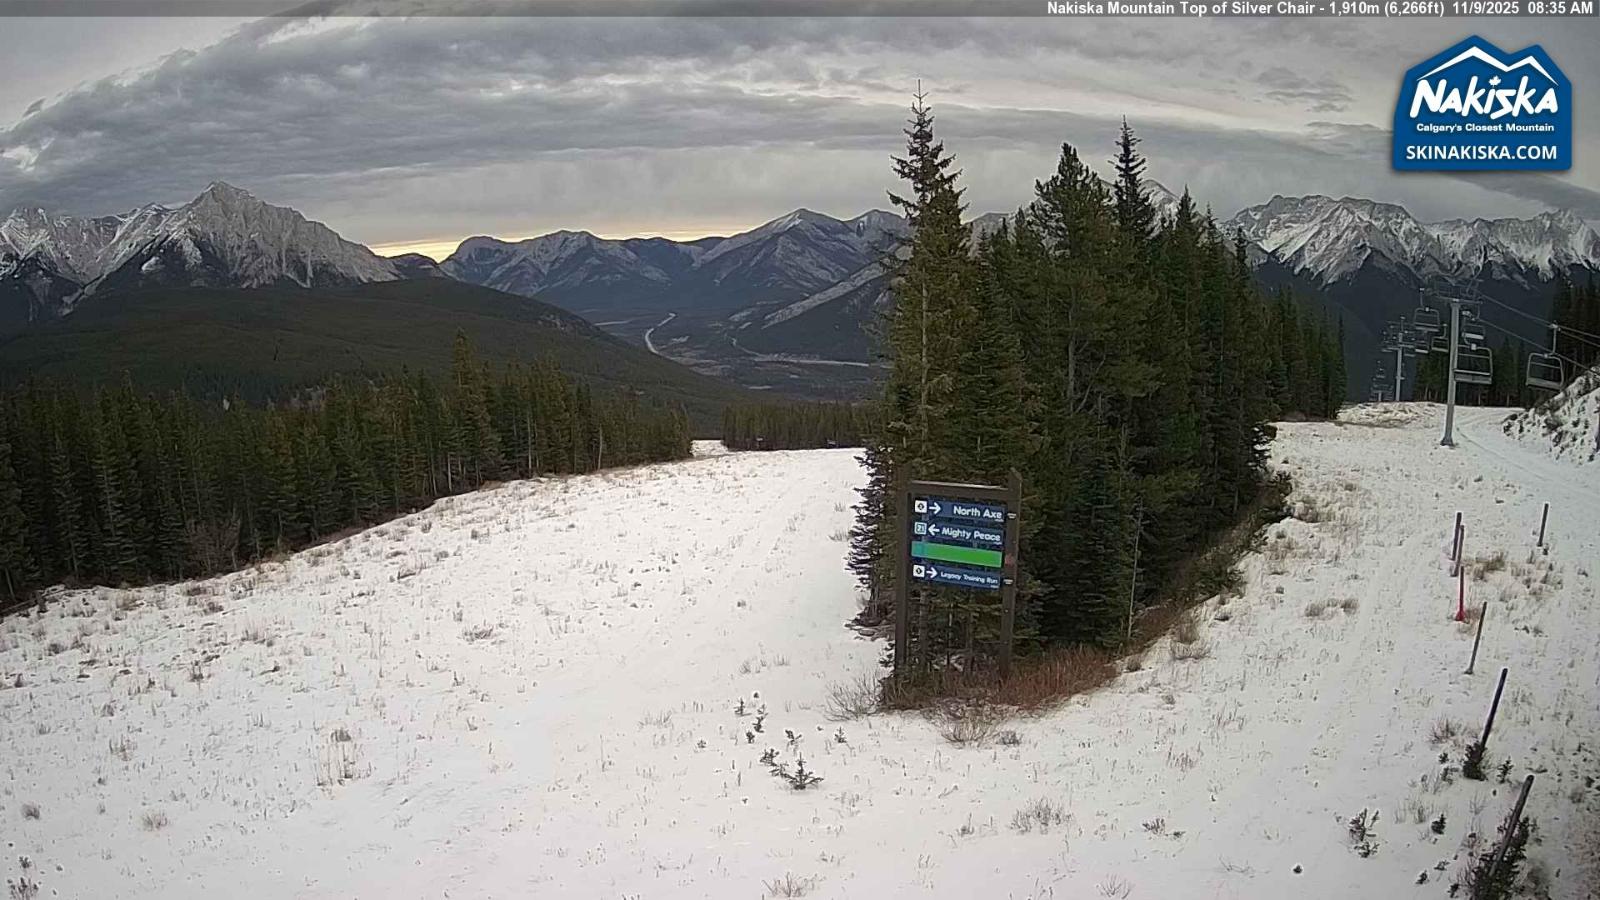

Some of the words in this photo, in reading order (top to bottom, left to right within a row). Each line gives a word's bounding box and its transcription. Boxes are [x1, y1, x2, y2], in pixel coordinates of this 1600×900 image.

[953, 505, 981, 517] North
[982, 508, 1003, 519] Axe
[941, 526, 972, 539] Mighty
[973, 530, 1001, 542] Peace
[963, 574, 985, 584] Training
[986, 577, 998, 585] Run
